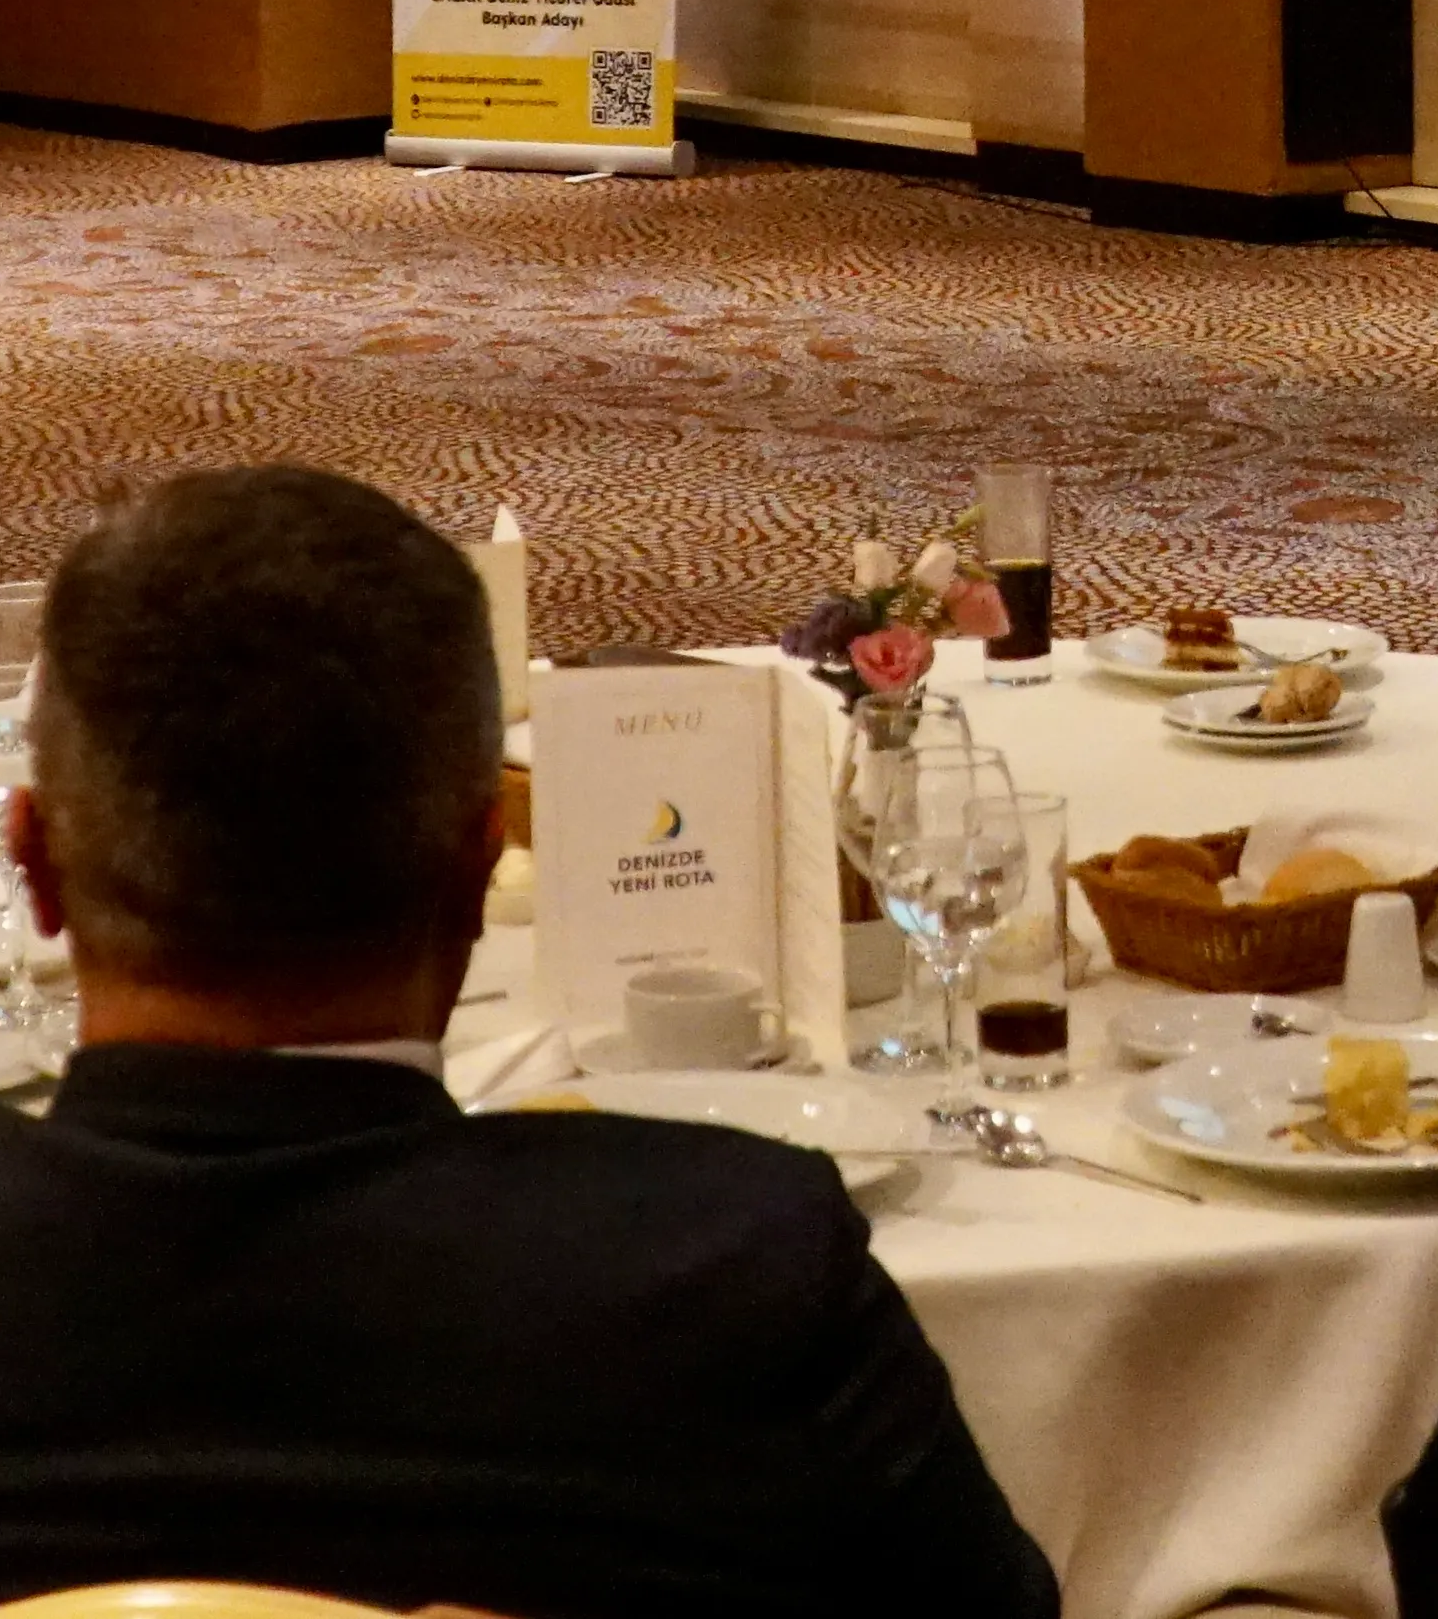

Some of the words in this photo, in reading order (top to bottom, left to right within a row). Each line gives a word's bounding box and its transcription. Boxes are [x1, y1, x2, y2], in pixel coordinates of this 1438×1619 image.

[482, 11, 537, 30] Başkan
[541, 12, 584, 31] Adayı
[663, 869, 715, 889] ROTA
